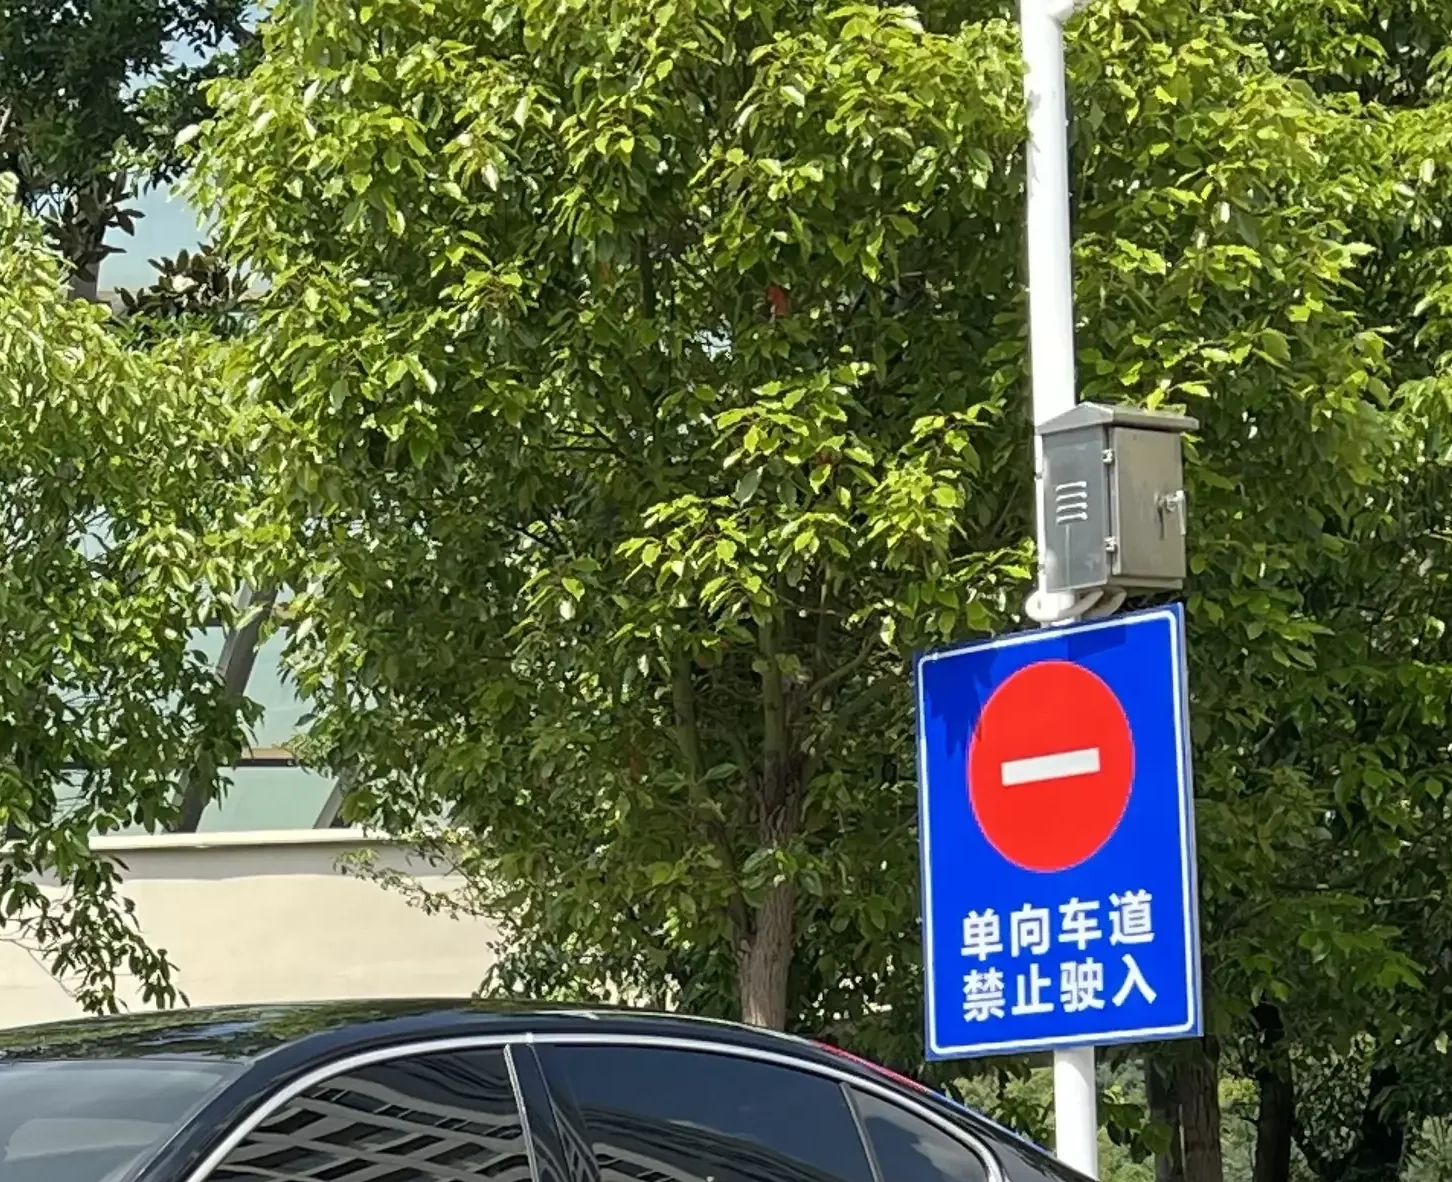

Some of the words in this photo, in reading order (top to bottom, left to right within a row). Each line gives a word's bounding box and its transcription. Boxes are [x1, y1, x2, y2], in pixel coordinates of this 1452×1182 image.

[961, 889, 1154, 961] 单向车道
[962, 953, 1157, 1023] 禁止驶入
